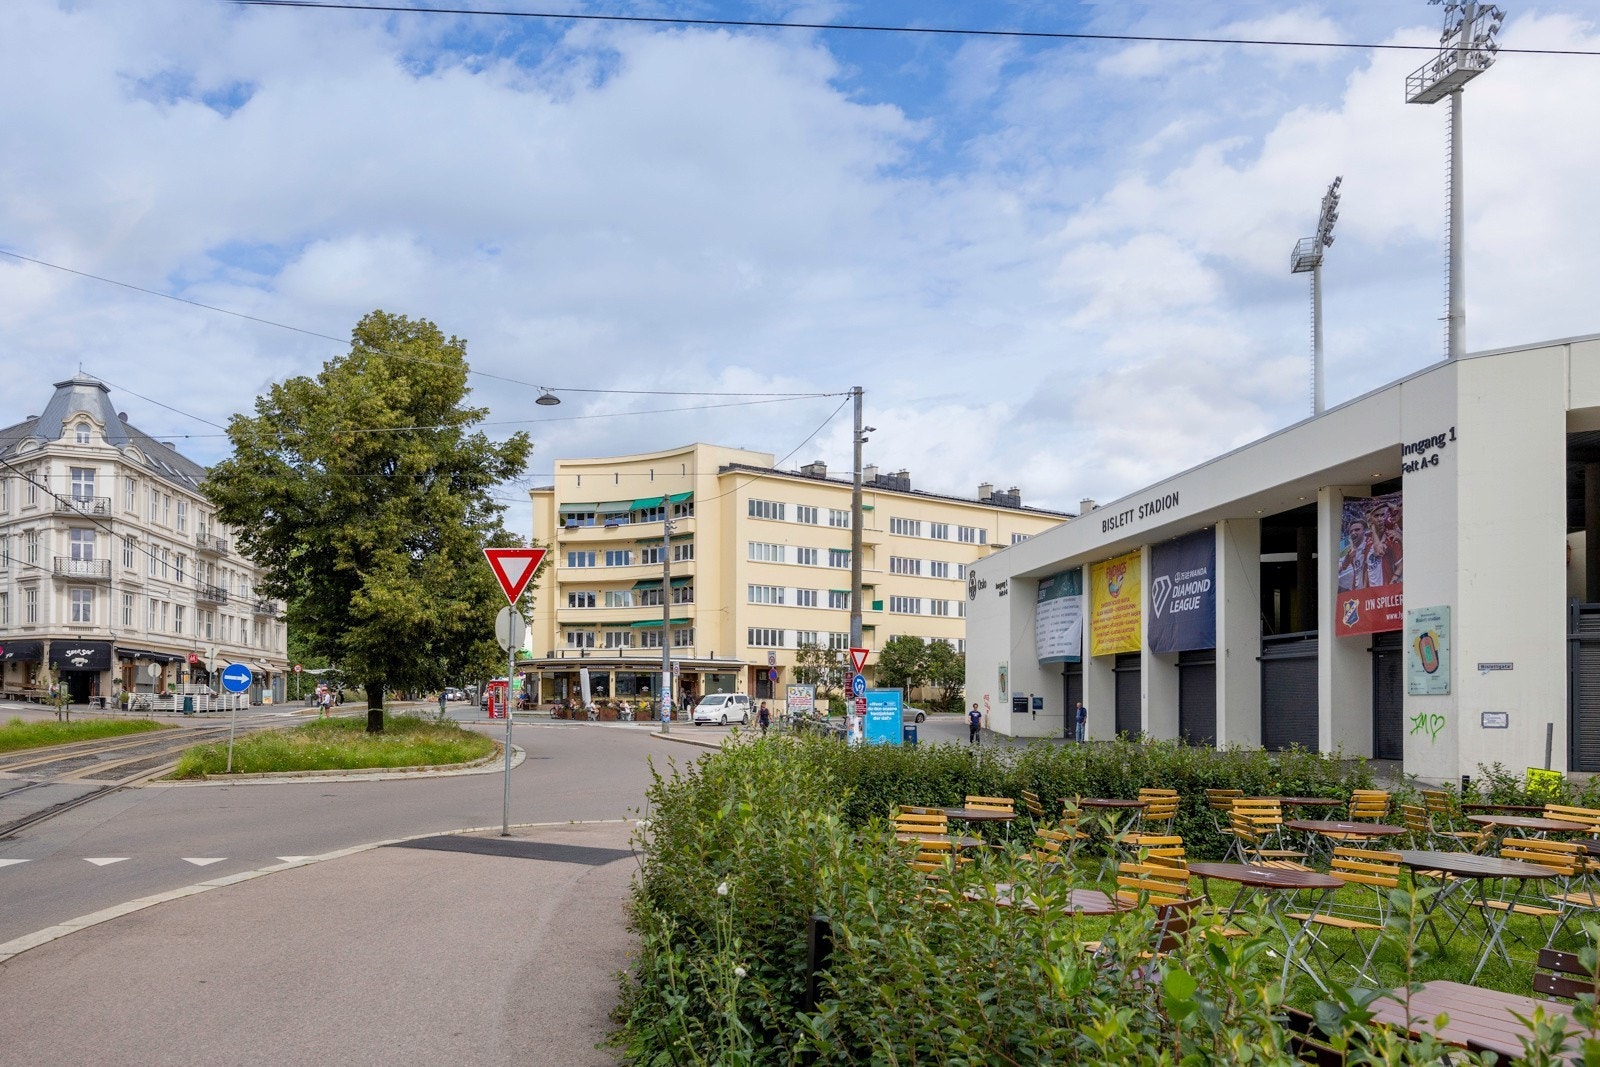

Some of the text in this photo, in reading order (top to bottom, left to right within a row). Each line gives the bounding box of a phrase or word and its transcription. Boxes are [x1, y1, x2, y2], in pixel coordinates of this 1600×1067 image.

[1401, 426, 1457, 457] Inngang 1
[1401, 460, 1419, 475] Felt
[1102, 491, 1179, 533] BISLETT STADION
[978, 578, 987, 590] Oslo
[1172, 579, 1210, 598] DIAMOND
[1170, 596, 1201, 613] LEAGUE
[1365, 599, 1375, 610] LYN
